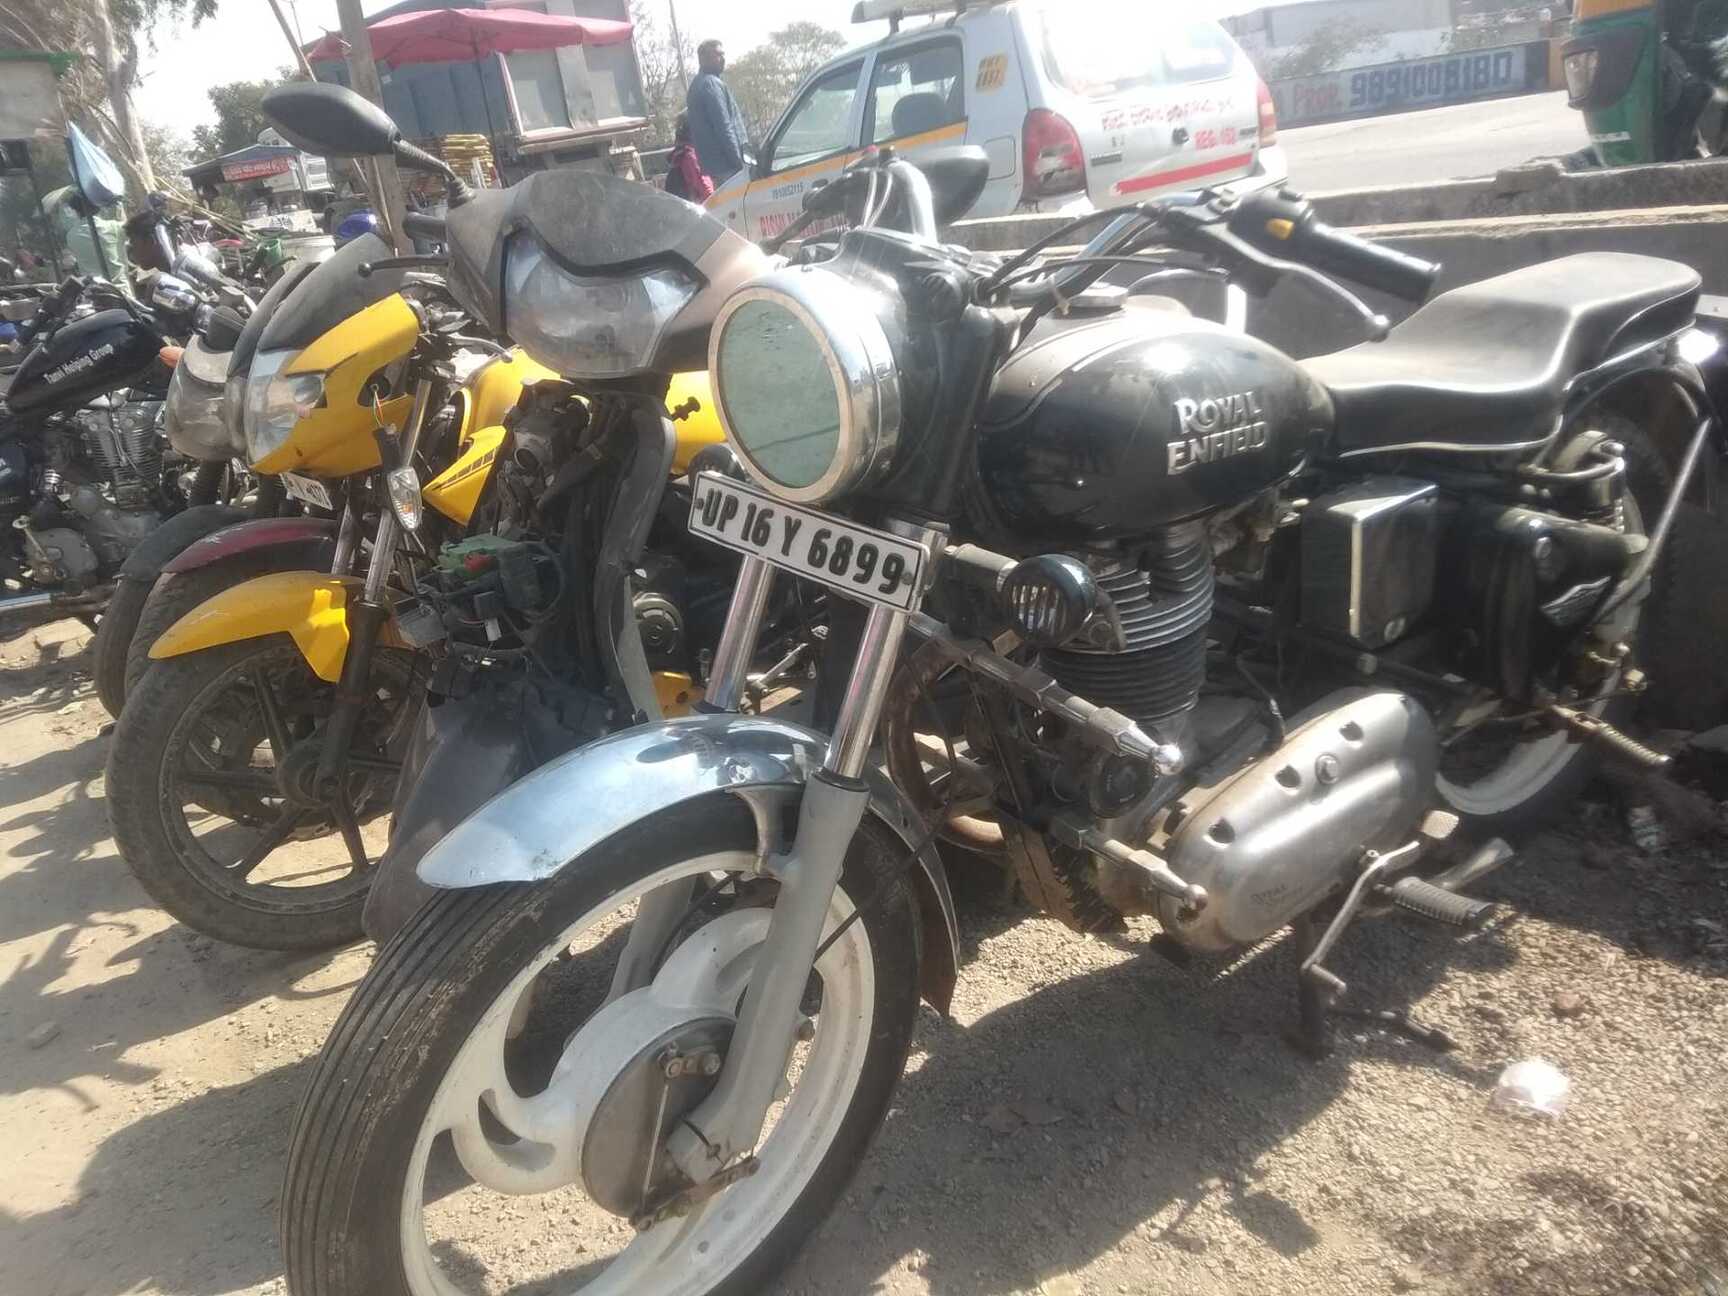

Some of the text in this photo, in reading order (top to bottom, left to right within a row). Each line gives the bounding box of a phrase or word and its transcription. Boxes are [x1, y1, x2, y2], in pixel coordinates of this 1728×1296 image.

[1173, 391, 1263, 434] ROYAL
[1167, 421, 1267, 475] ENFIELD
[701, 488, 906, 595] UP 16 Y 6899
